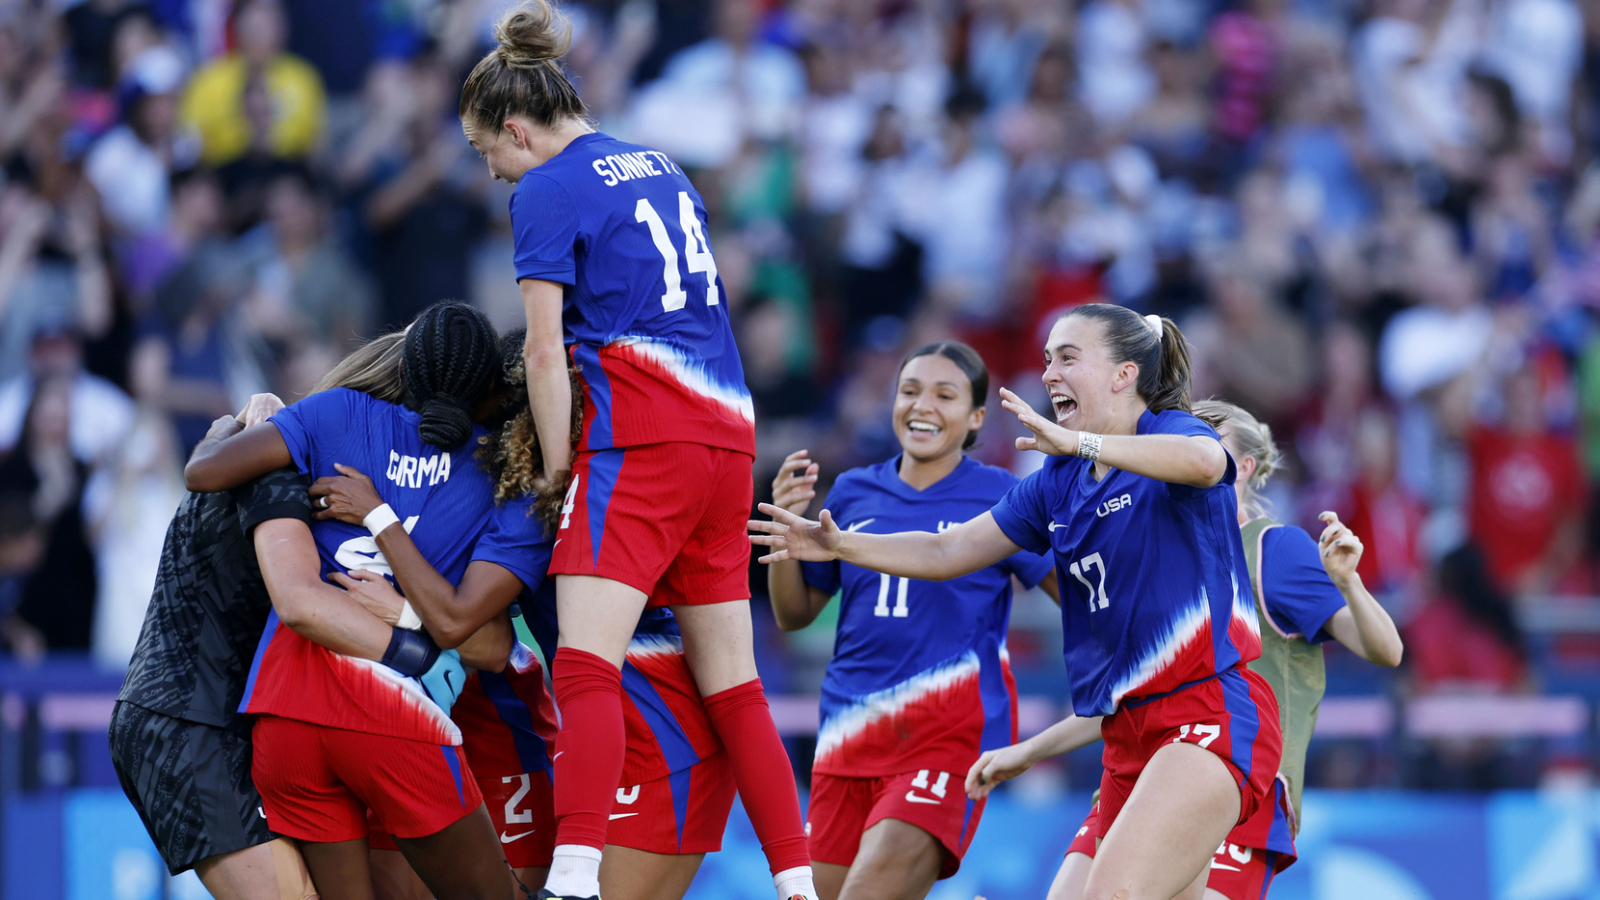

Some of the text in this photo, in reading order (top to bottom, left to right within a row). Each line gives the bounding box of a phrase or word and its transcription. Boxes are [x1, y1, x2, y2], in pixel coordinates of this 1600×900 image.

[634, 191, 719, 313] 14
[560, 473, 580, 529] 4
[1096, 493, 1132, 518] USA
[874, 572, 909, 618] 11
[1069, 552, 1110, 613] 17
[1173, 723, 1221, 749] 17
[502, 773, 533, 824] 2
[911, 769, 950, 799] 11
